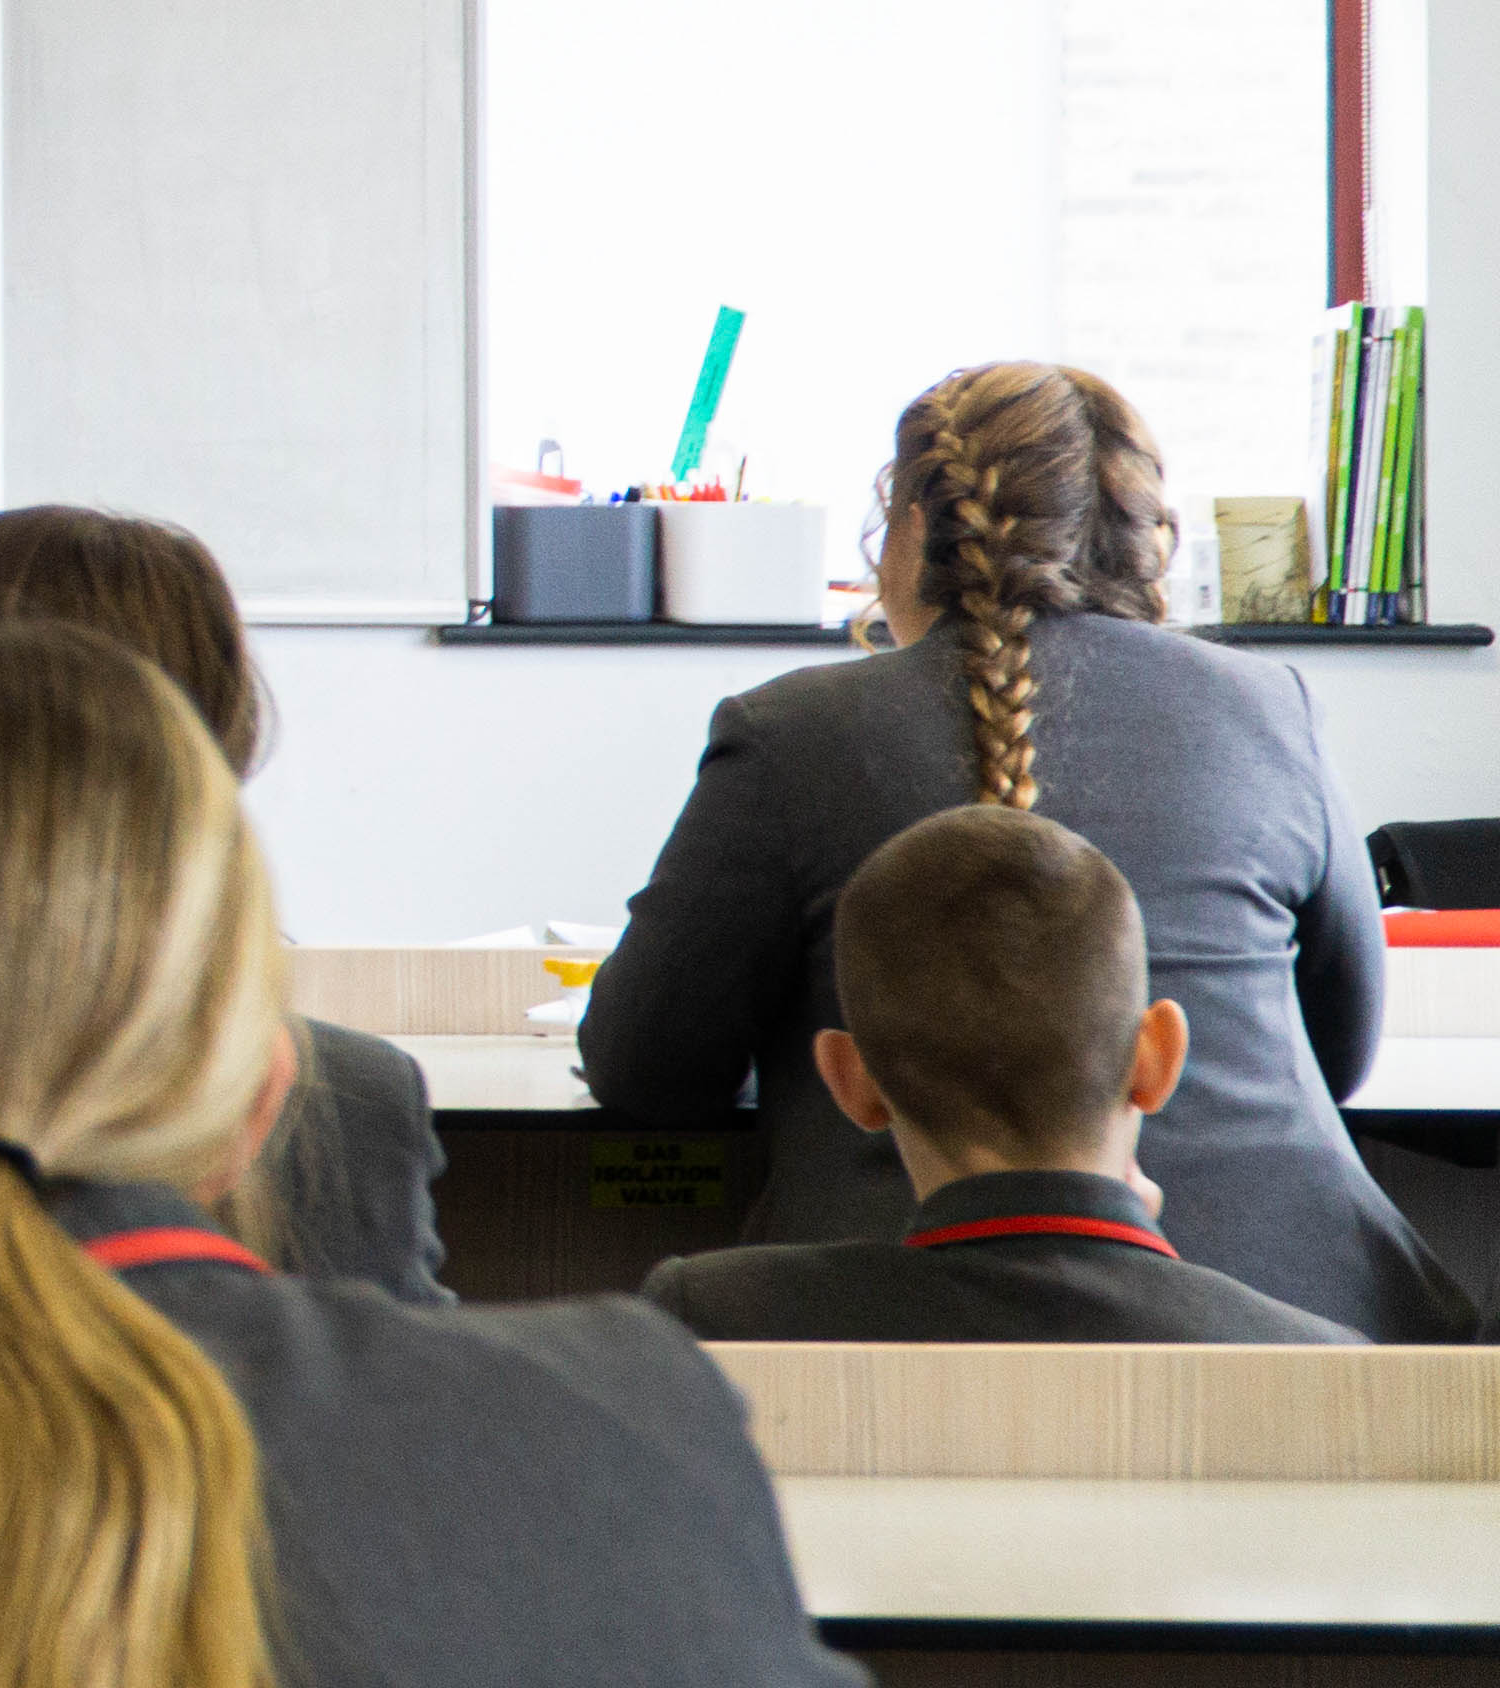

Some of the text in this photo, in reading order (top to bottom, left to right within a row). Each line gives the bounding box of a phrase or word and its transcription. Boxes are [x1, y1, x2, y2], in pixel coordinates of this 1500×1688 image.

[633, 1144, 682, 1161] GAS
[595, 1165, 721, 1182] ISOLATION
[621, 1186, 698, 1204] VALVE
